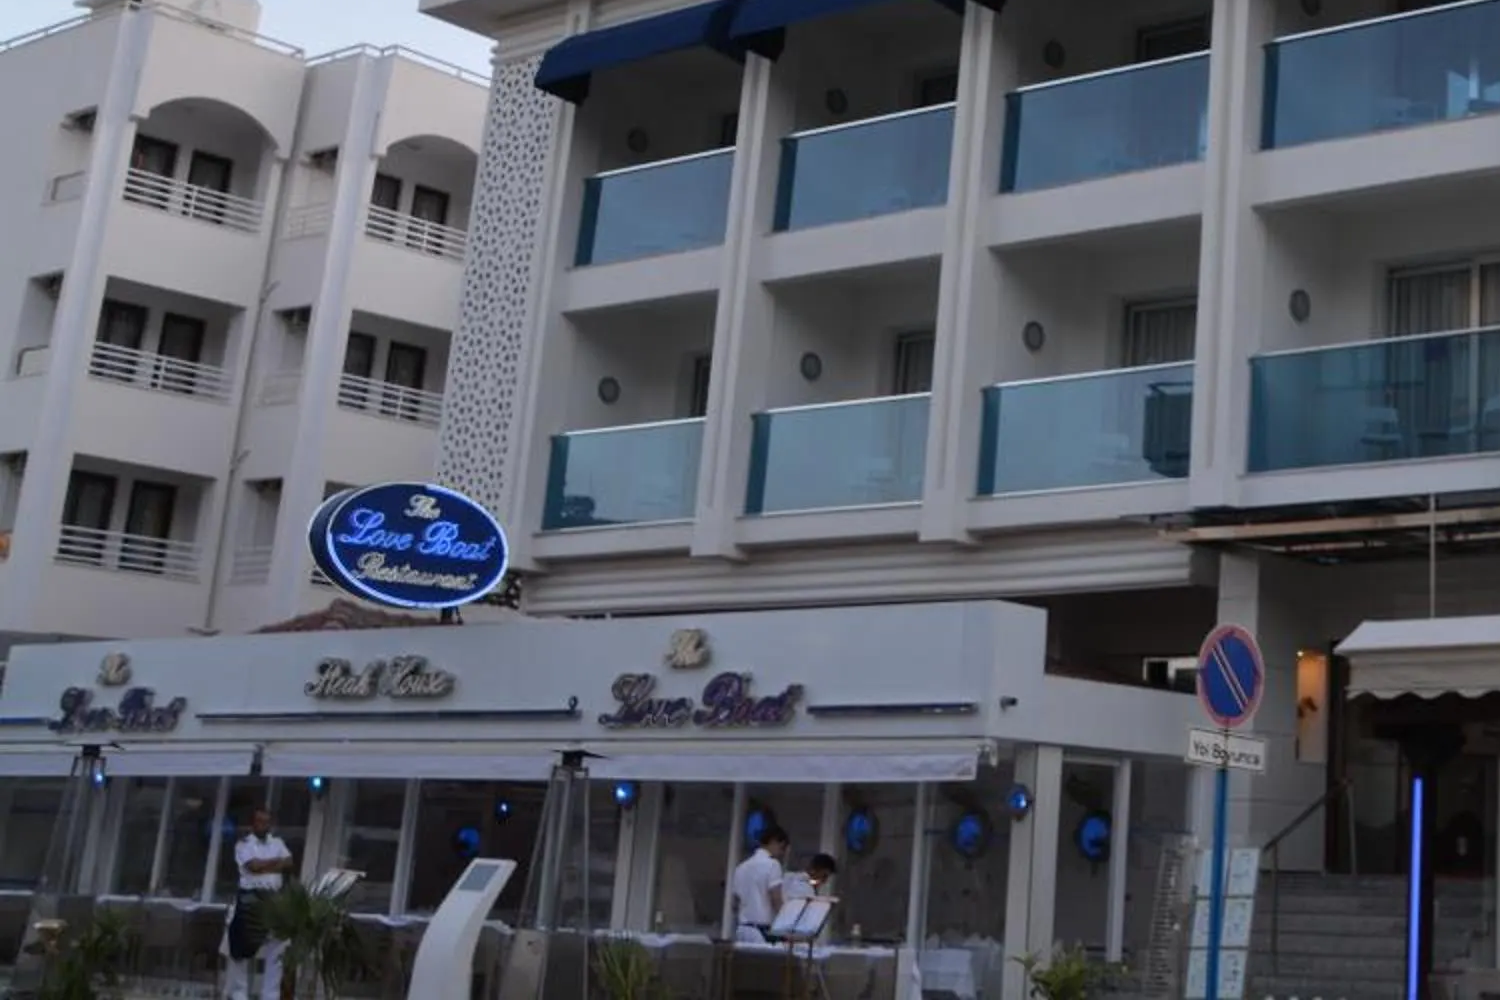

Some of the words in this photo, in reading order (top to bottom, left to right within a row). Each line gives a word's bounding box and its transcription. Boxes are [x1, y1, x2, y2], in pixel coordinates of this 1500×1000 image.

[404, 493, 441, 520] The
[338, 507, 415, 551] Love
[417, 520, 497, 561] Boat
[351, 551, 479, 590] Restaurant
[380, 654, 457, 699] House
[598, 672, 693, 728] Love
[693, 671, 804, 729] Boat
